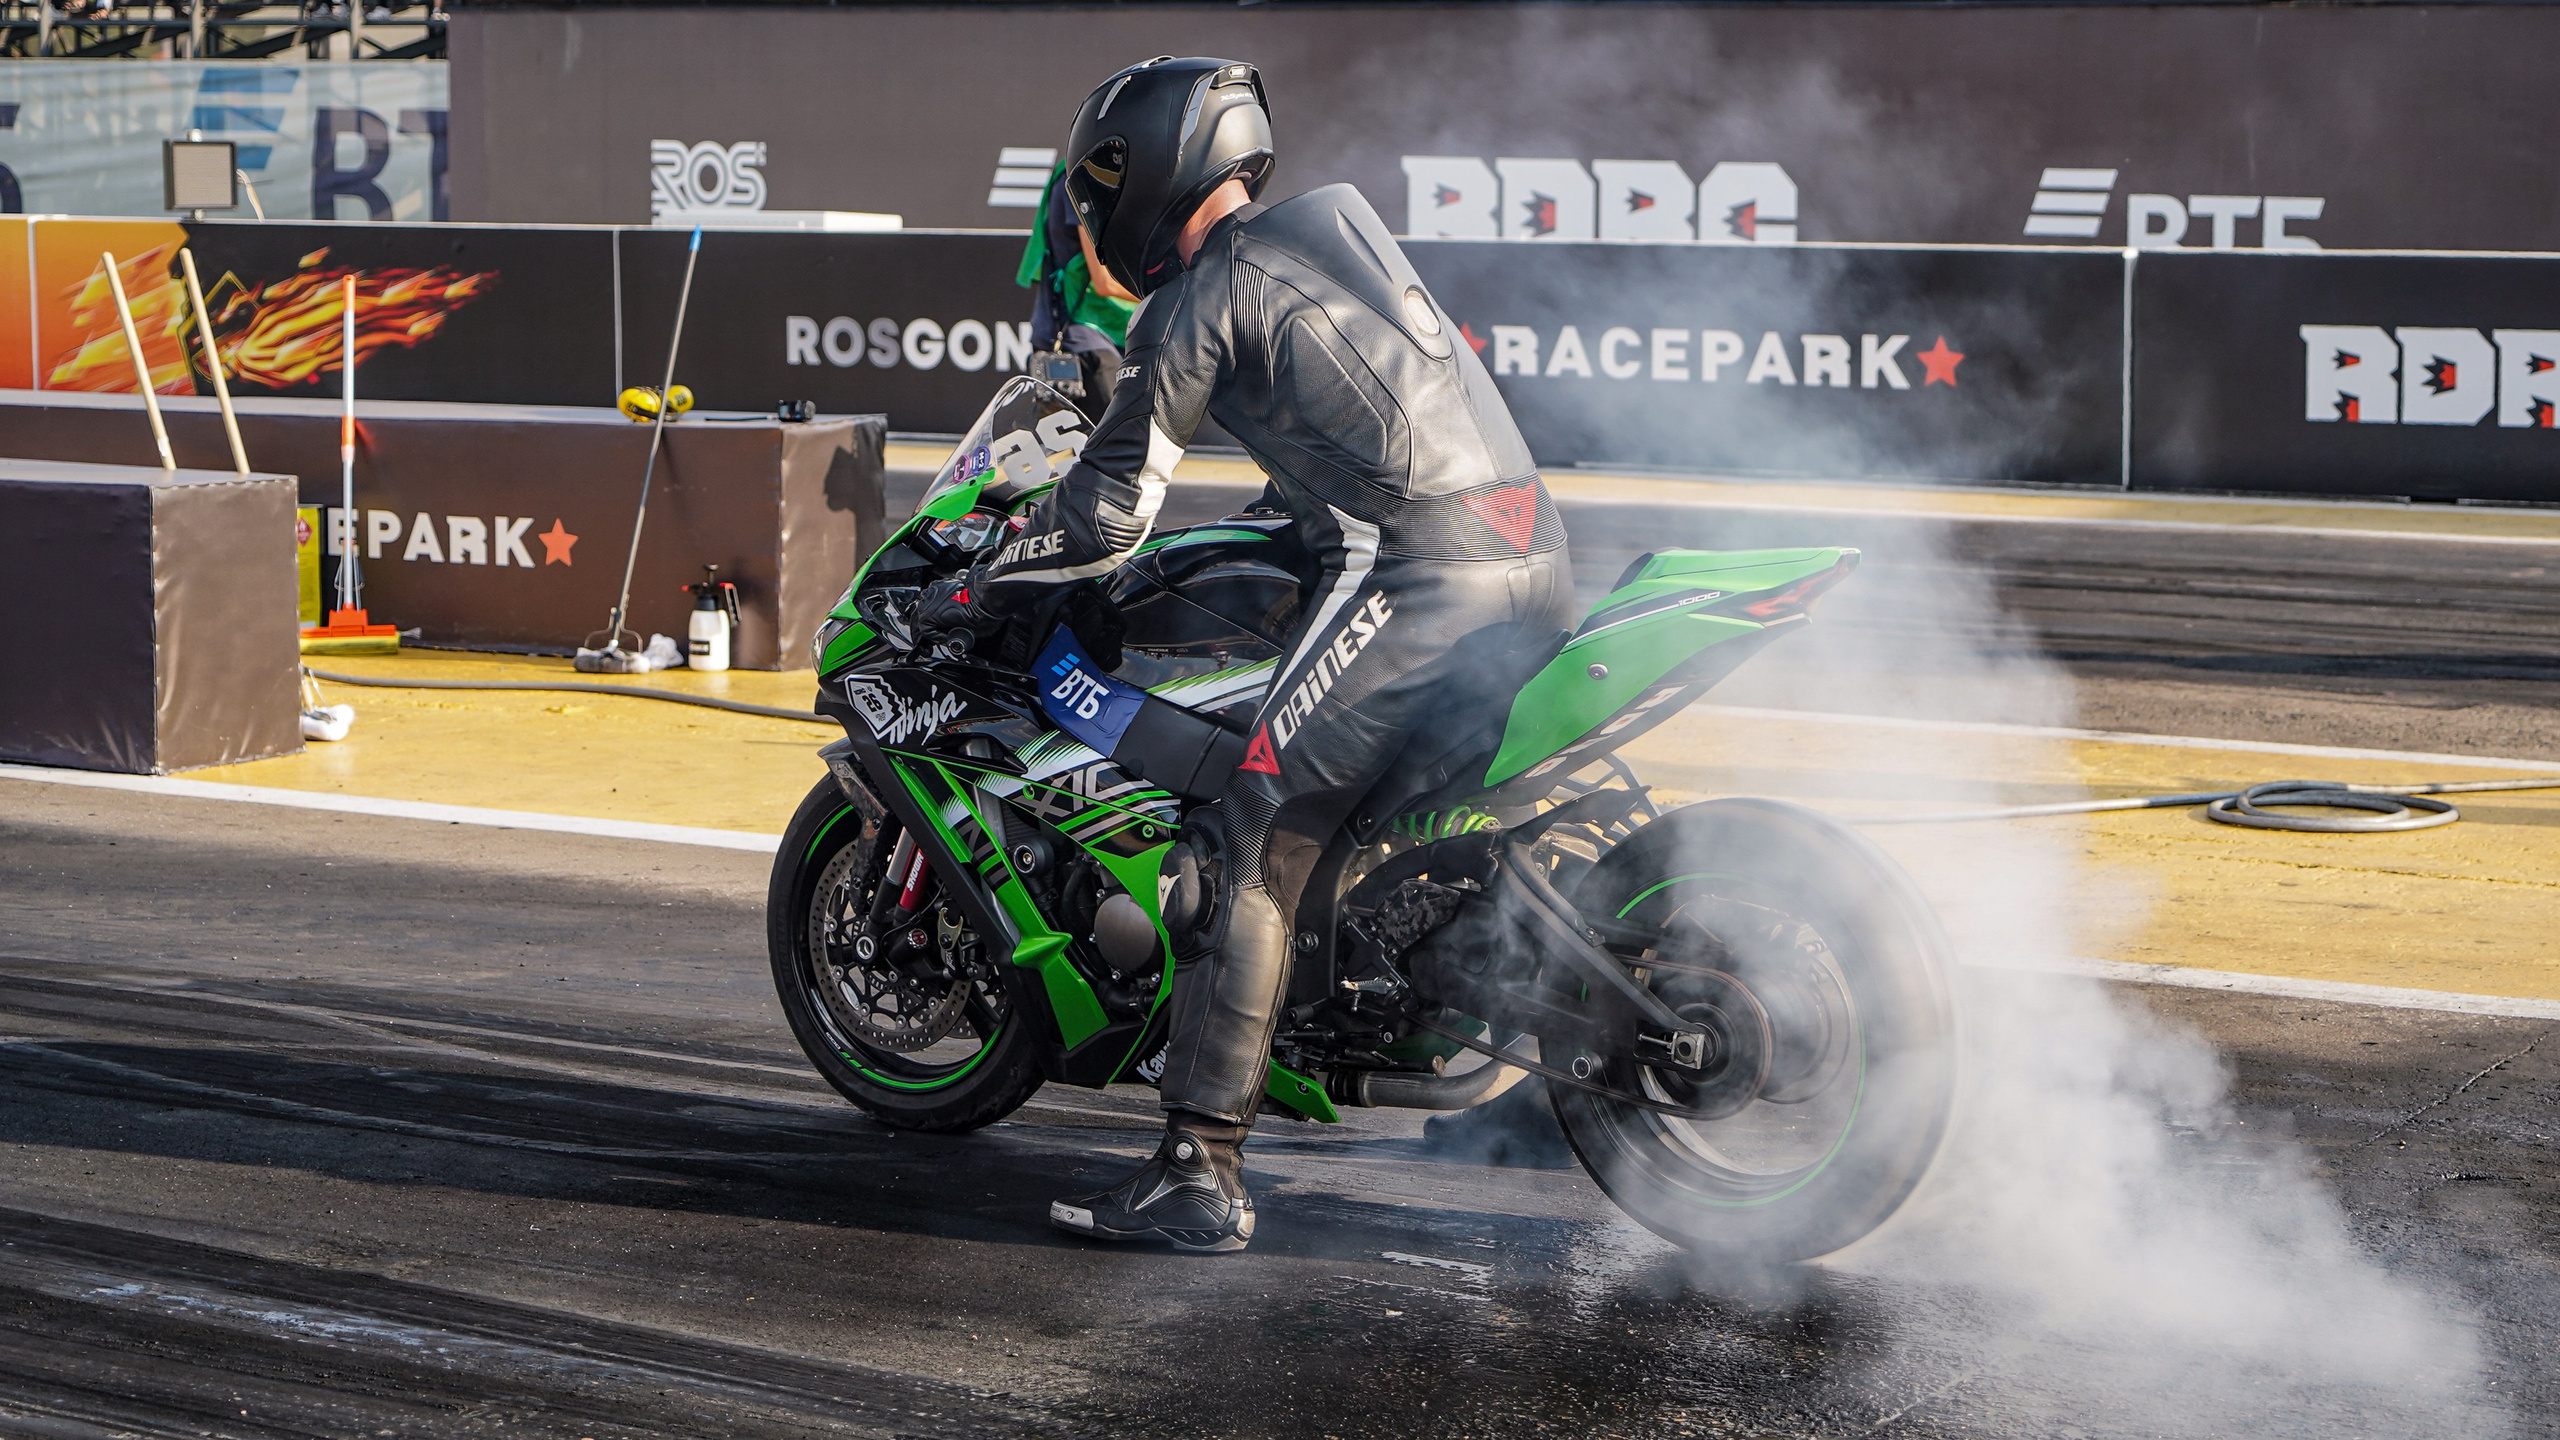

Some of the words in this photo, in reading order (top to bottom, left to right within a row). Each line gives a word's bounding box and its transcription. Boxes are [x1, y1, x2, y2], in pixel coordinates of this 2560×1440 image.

[651, 139, 768, 210] ROS
[786, 316, 1033, 372] ROSGON
[1492, 325, 1911, 390] RACEPARK
[327, 507, 536, 568] EPARK
[1678, 591, 1720, 606] 1000
[862, 693, 884, 713] 26
[1050, 668, 1110, 719] ВТБ
[906, 852, 925, 892] SHOWA
[1136, 1040, 1170, 1083] Kaw
